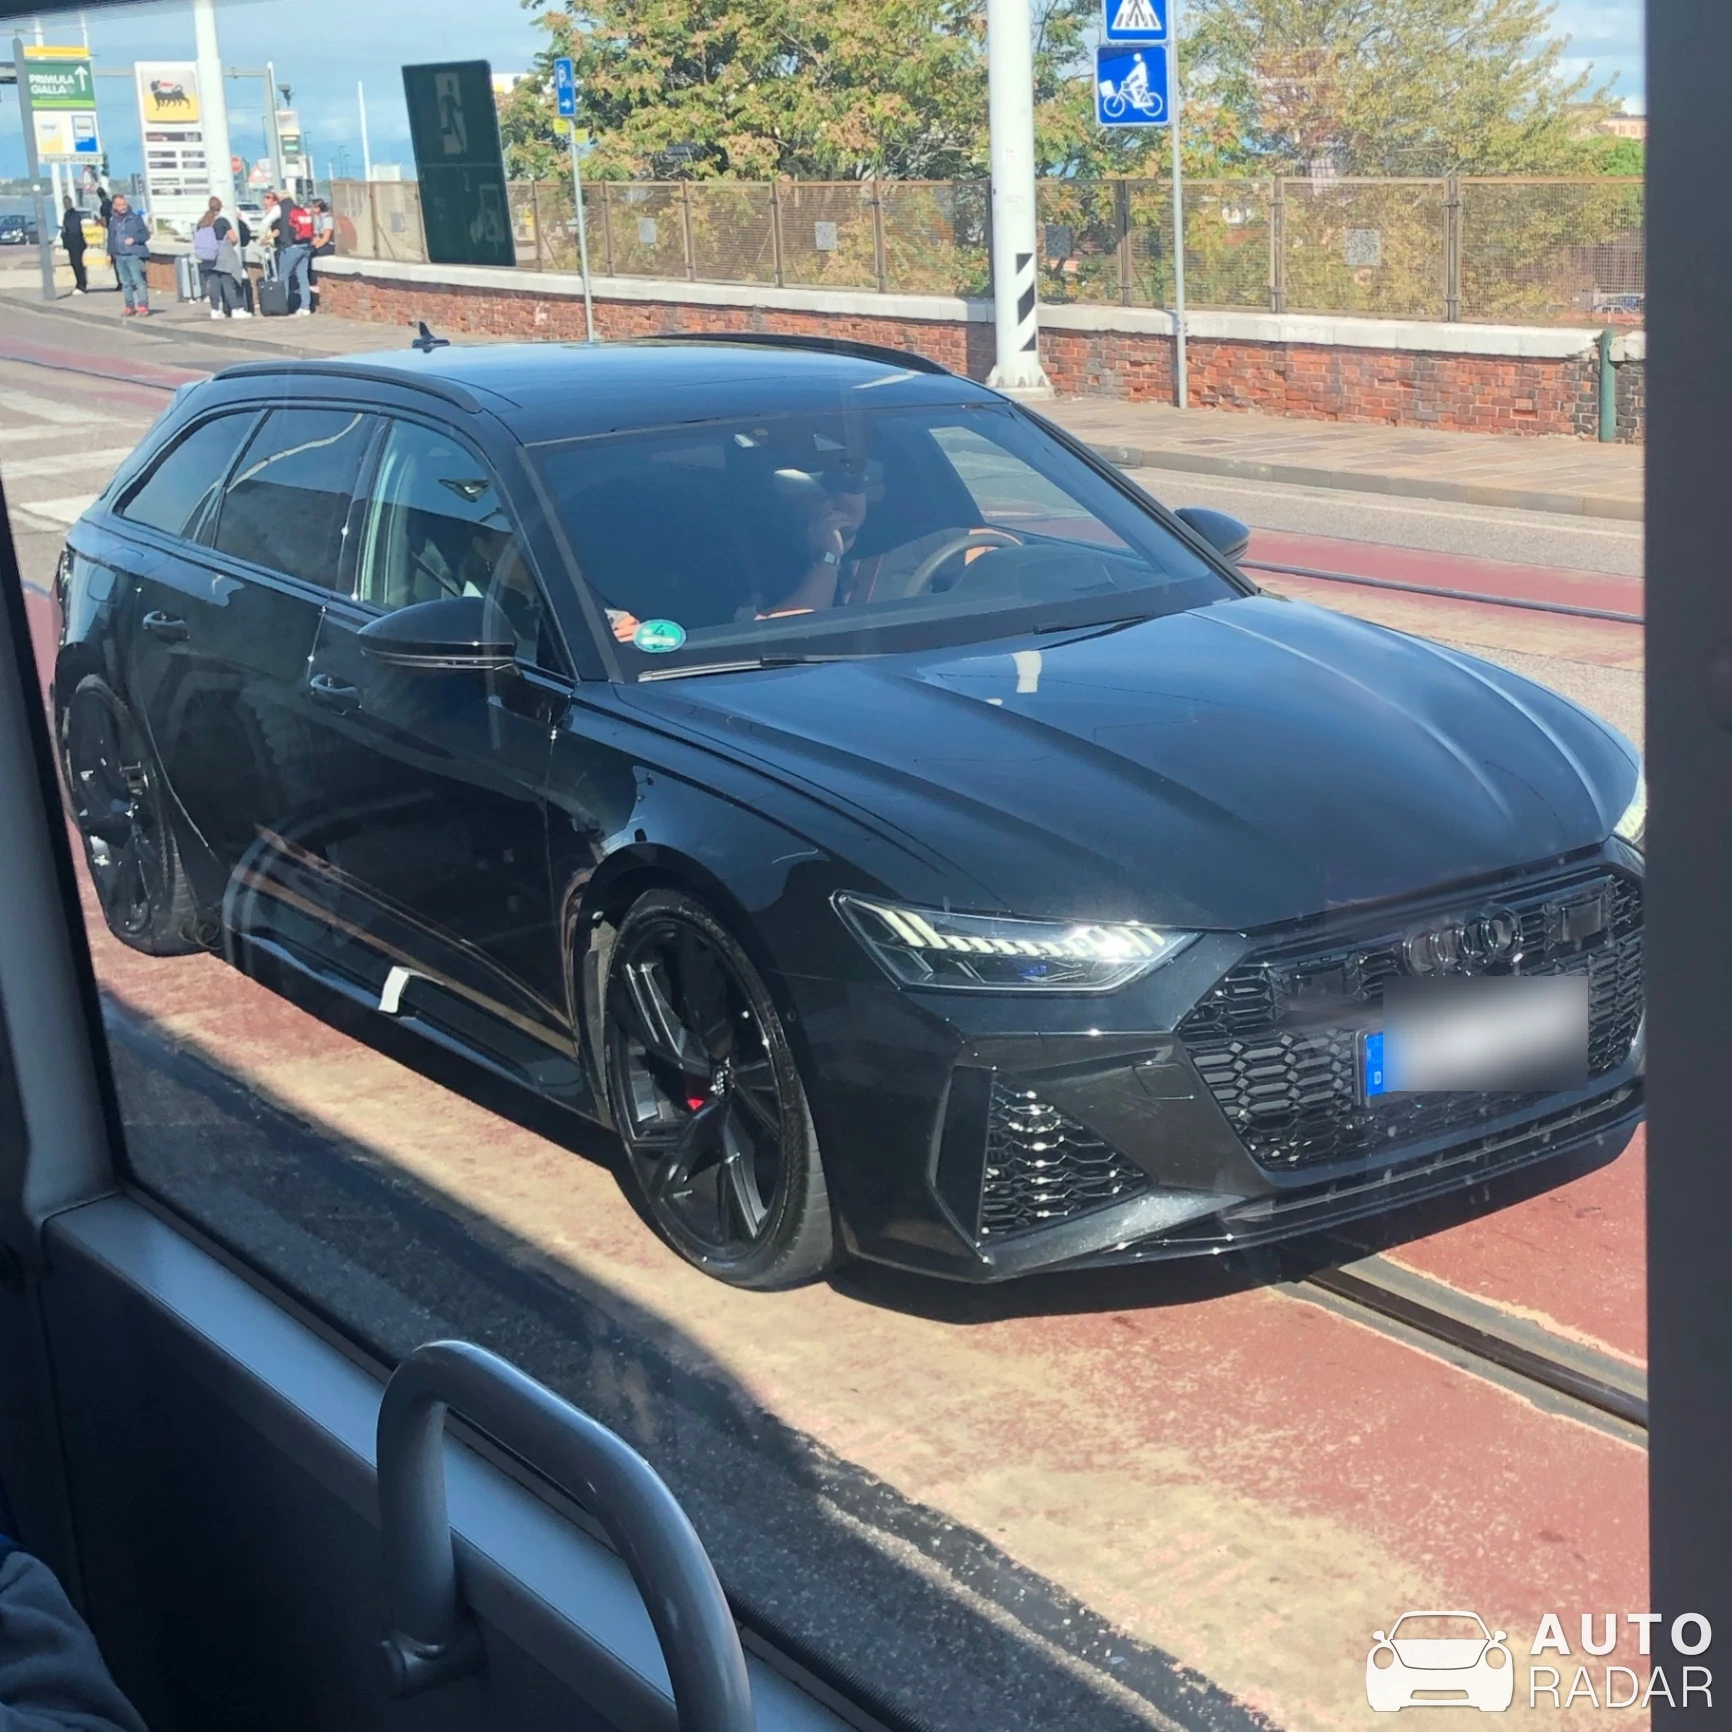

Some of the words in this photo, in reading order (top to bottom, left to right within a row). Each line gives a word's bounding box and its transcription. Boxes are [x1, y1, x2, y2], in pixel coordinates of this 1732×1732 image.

[29, 75, 75, 85] PRIMULA
[31, 85, 67, 95] GIALLA
[653, 624, 665, 636] 4
